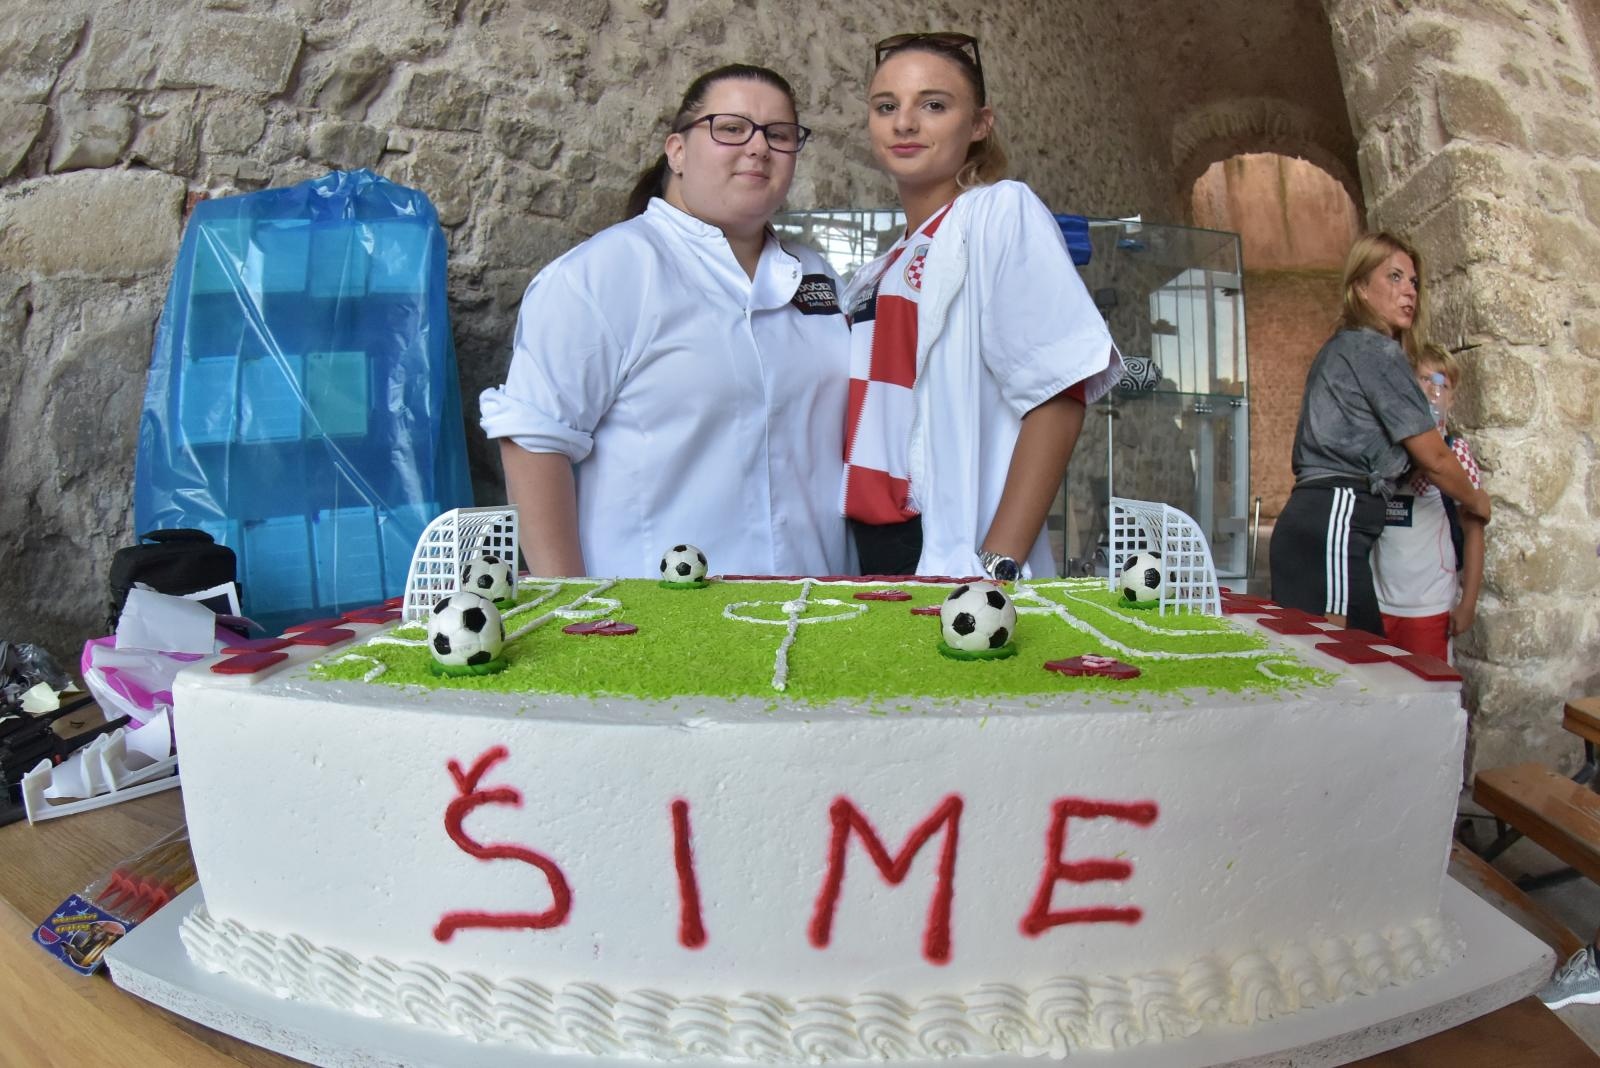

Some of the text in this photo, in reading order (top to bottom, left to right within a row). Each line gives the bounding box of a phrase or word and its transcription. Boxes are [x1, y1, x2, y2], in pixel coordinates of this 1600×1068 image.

[799, 281, 833, 291] DOČE
[794, 290, 836, 303] VATRE
[434, 746, 1158, 965] ŠIME
